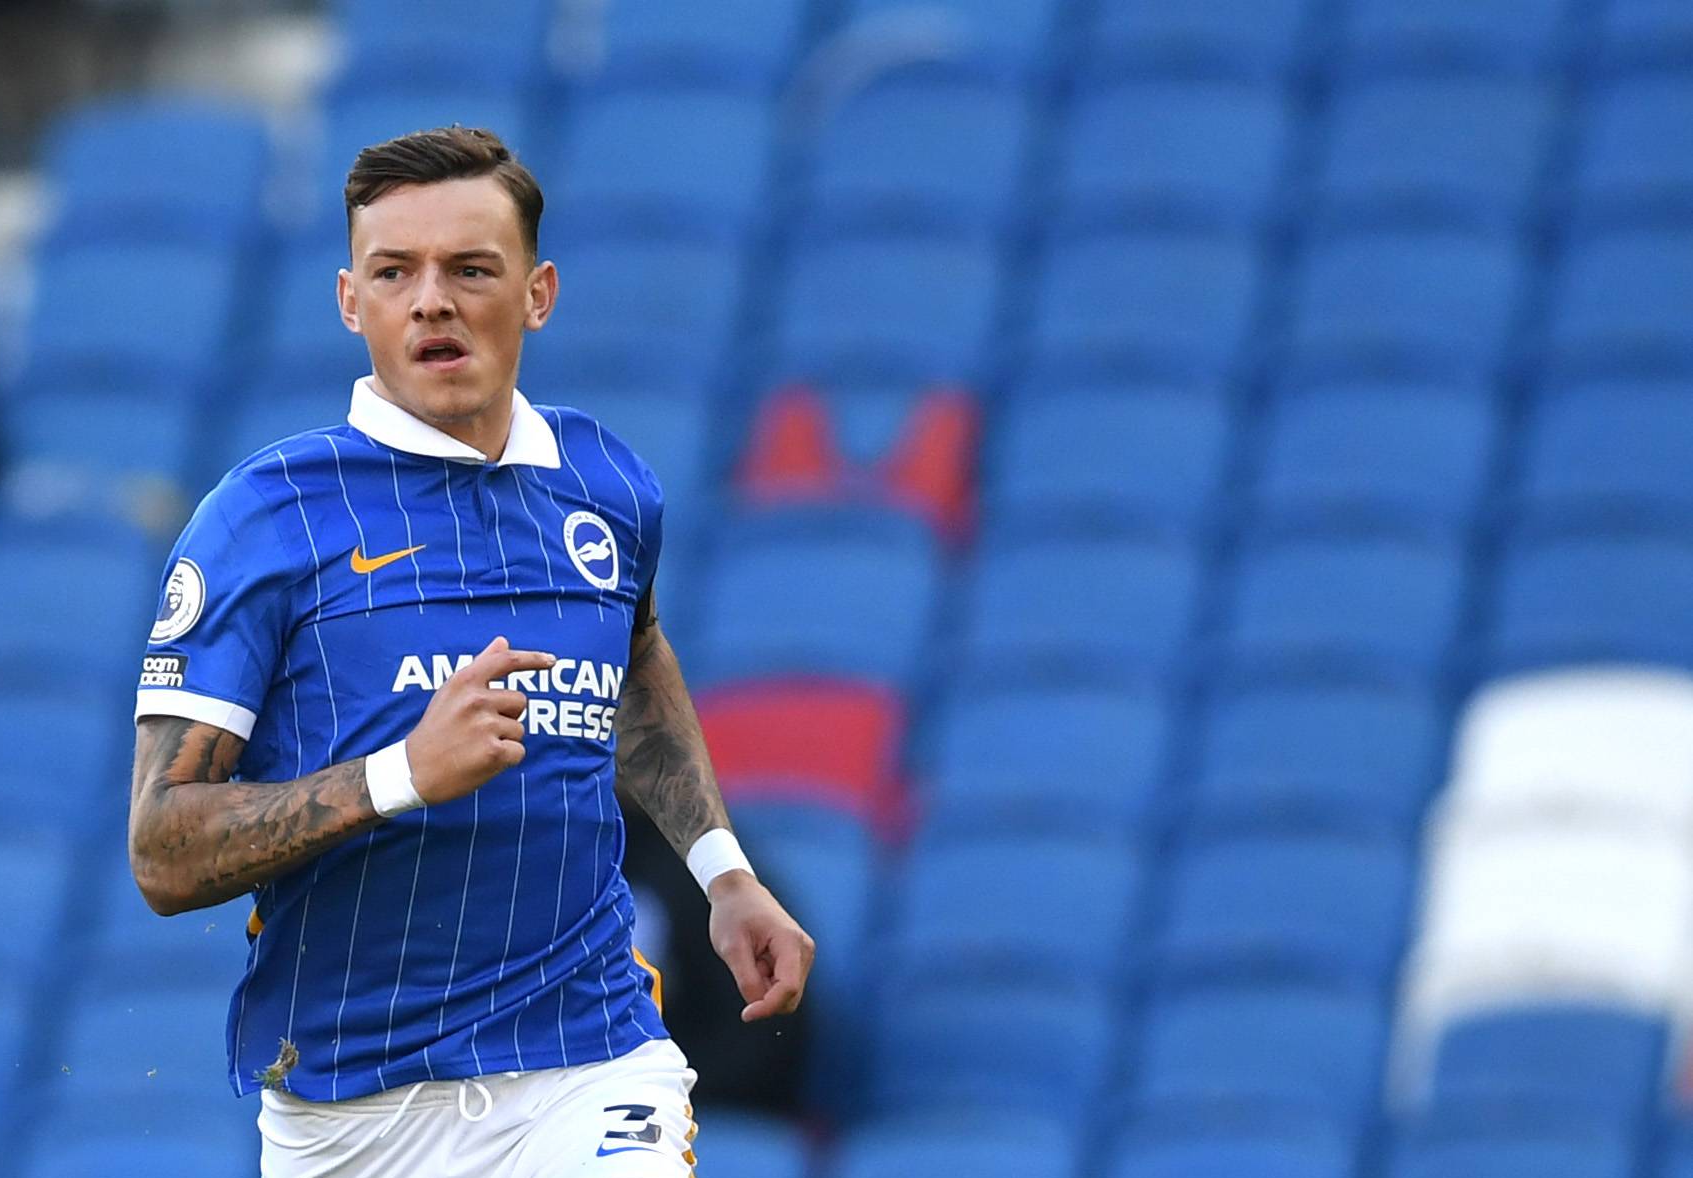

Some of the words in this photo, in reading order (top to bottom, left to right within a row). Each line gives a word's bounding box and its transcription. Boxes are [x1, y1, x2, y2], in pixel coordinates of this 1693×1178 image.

[392, 653, 624, 700] AMRICAN
[517, 698, 617, 742] RESS
[603, 1104, 662, 1144] 3
